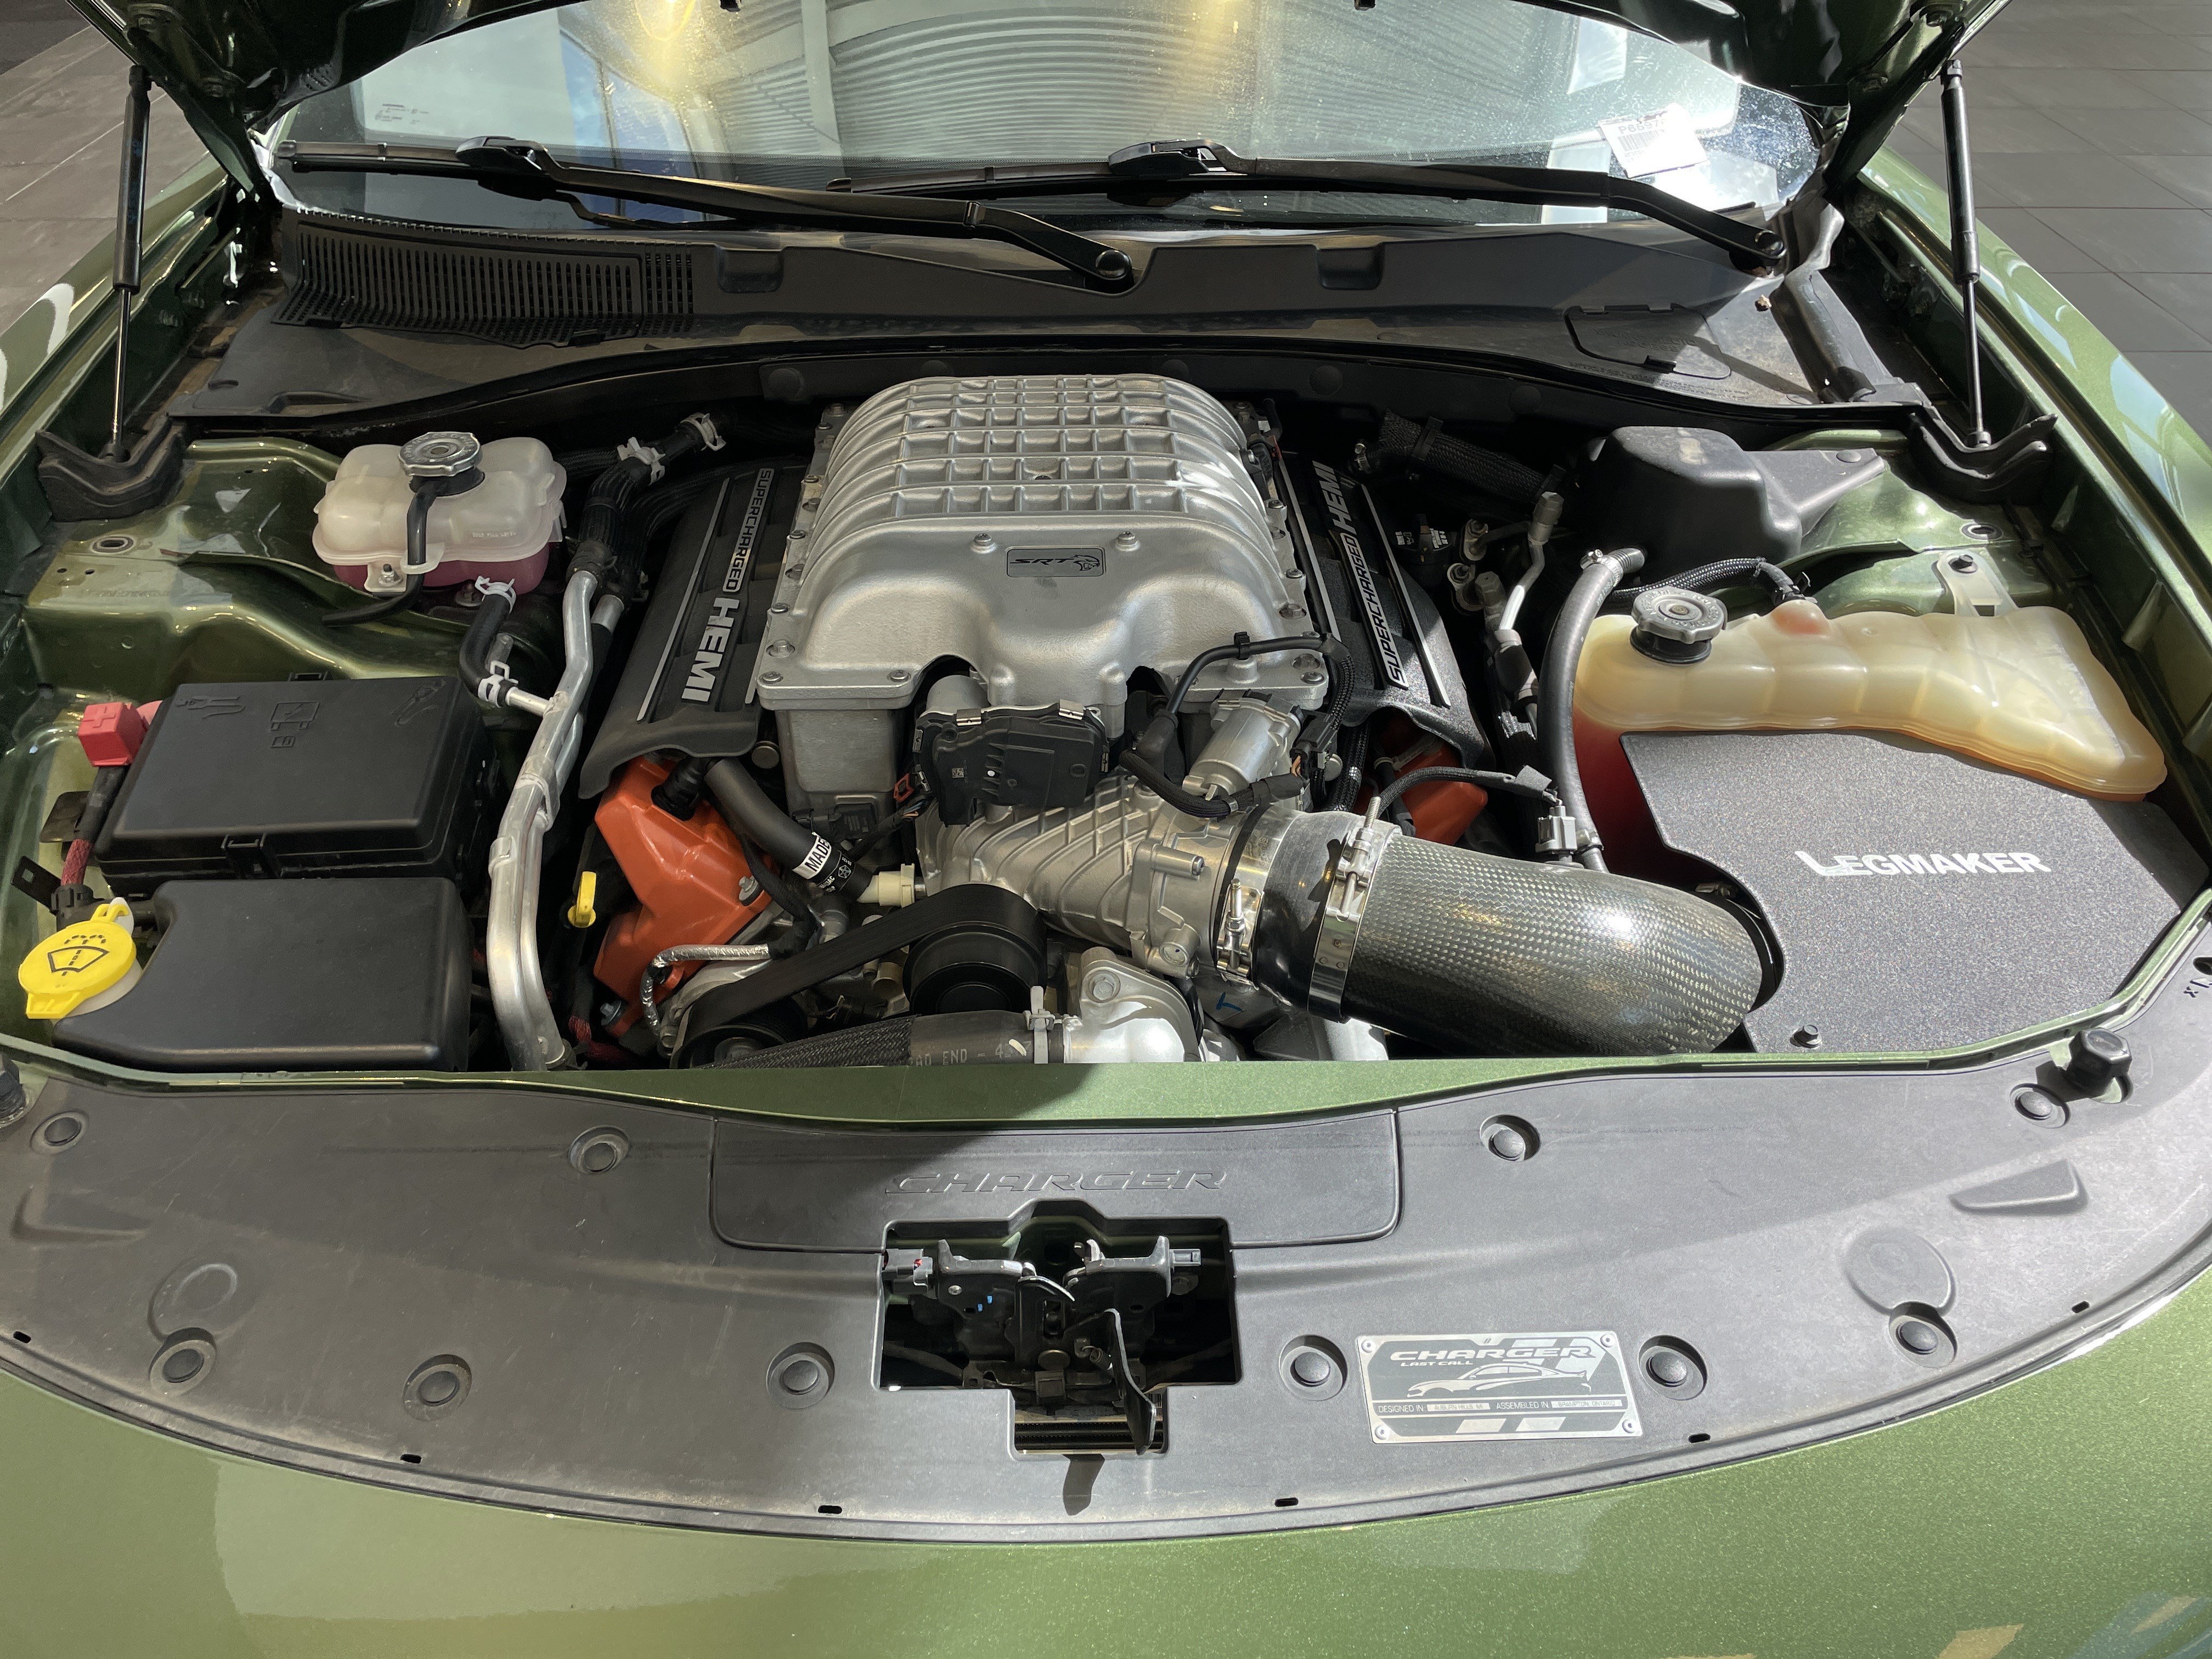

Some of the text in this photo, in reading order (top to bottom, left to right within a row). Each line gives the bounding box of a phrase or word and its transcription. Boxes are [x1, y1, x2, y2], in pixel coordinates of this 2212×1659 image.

[1312, 460, 1356, 535] HEMI
[725, 469, 772, 590] SUPERCHARGED
[1343, 534, 1404, 685] SUPERCHARGED
[681, 597, 740, 702] HEMI
[804, 837, 831, 872] MADE
[1795, 851, 2051, 876] LEGMAKER
[943, 1048, 967, 1065] END
[885, 1170, 1227, 1194] CHARGER
[1390, 1346, 1596, 1361] CHARGER
